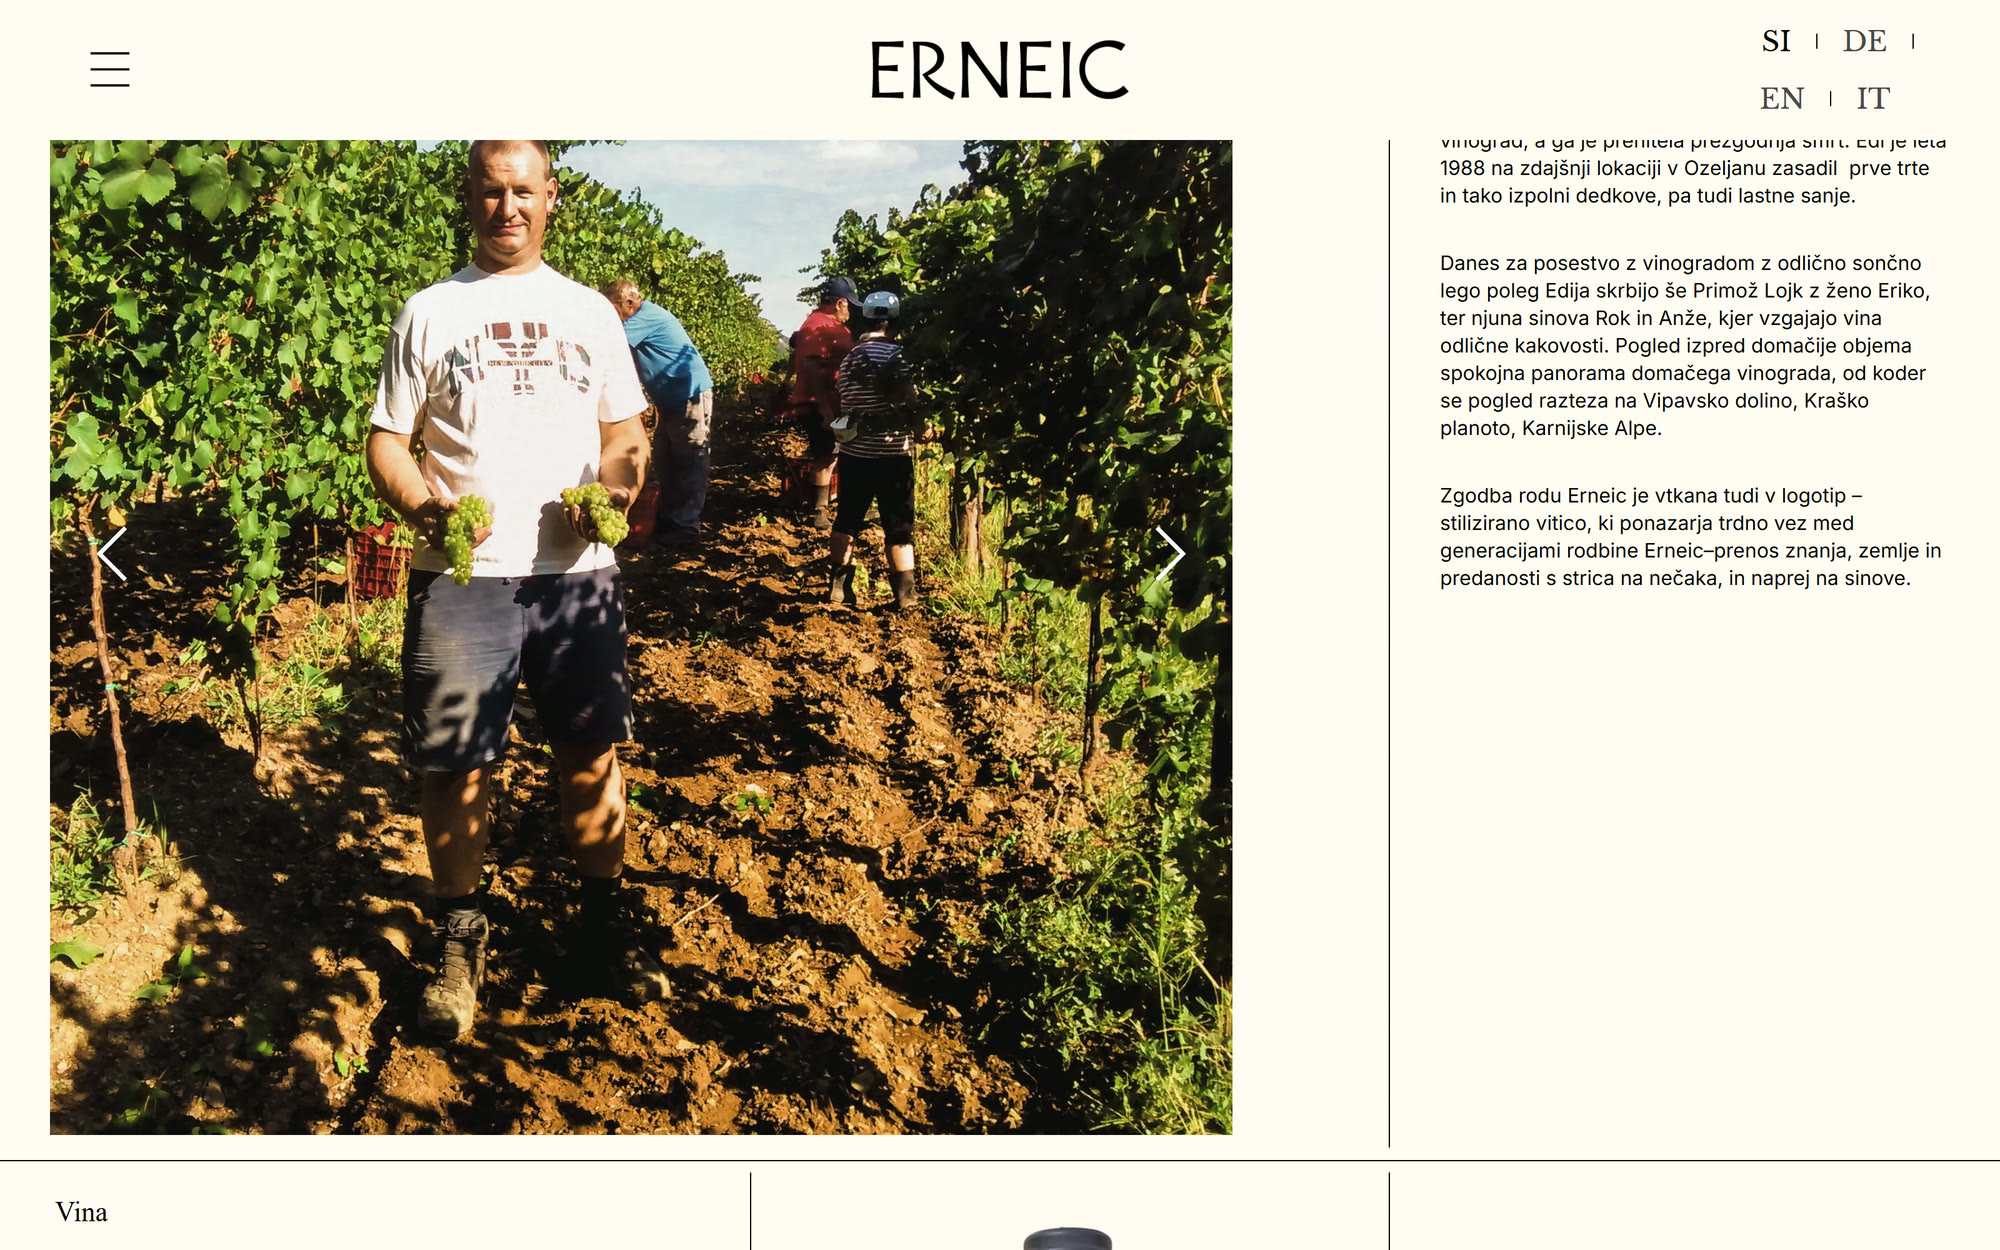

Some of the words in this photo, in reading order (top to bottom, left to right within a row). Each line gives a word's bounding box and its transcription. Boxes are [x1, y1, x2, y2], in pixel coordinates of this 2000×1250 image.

[1762, 30, 1790, 52] SI
[1843, 30, 1887, 52] DE
[872, 40, 1129, 100] ERNEIC
[1760, 87, 1804, 110] EN
[1857, 87, 1891, 110] IT
[1441, 160, 1485, 175] 1988
[1492, 164, 1513, 176] na
[1520, 159, 1590, 179] zdajšnji
[1598, 160, 1660, 179] lokaciji
[1668, 164, 1678, 175] v
[1685, 160, 1765, 179] Ozeljanu
[1773, 160, 1837, 176] zasadil
[1850, 164, 1891, 180] prve
[1897, 161, 1929, 176] trte
[1441, 187, 1456, 203] in
[1462, 188, 1502, 203] tako
[1509, 187, 1569, 207] izpolni
[1576, 188, 1661, 206] dedkove,
[1669, 191, 1690, 207] pa
[1697, 187, 1732, 203] tudi
[1739, 188, 1794, 203] lastne
[1802, 187, 1855, 207] sanje.
[1441, 255, 1499, 271] Danes
[1506, 259, 1527, 270] za
[1535, 256, 1619, 275] posestvo
[1627, 259, 1636, 270] z
[1643, 255, 1754, 275] vinogradom
[1762, 259, 1771, 270] z
[1778, 254, 1846, 271] odlično
[1853, 254, 1921, 271] sončno
[1441, 283, 1480, 302] lego
[1488, 283, 1538, 302] poleg
[1546, 282, 1589, 302] Edija
[1597, 282, 1658, 302] skrbijo
[1666, 282, 1686, 298] še
[1694, 282, 1758, 298] Primož
[1765, 282, 1803, 302] Lojk
[1810, 286, 1819, 298] z
[1826, 282, 1871, 298] ženo
[1879, 282, 1929, 301] Eriko,
[1440, 311, 1465, 326] ter
[1472, 310, 1522, 329] njuna
[1529, 310, 1588, 326] sinova
[1597, 310, 1630, 326] Rok
[1637, 310, 1652, 325] in
[1659, 309, 1711, 329] Anže,
[1720, 310, 1753, 329] kjer
[1759, 310, 1837, 330] vzgajajo
[1844, 310, 1881, 326] vina
[1441, 337, 1508, 353] odlične
[1516, 337, 1608, 353] kakovosti.
[1617, 338, 1680, 357] Pogled
[1687, 337, 1744, 357] izpred
[1752, 337, 1836, 357] domačije
[1843, 337, 1911, 357] objema
[1441, 365, 1524, 384] spokojna
[1532, 368, 1625, 384] panorama
[1632, 364, 1730, 385] domačega
[1737, 365, 1835, 385] vinograda,
[1843, 365, 1865, 381] od
[1874, 365, 1926, 381] koder
[1441, 396, 1462, 408] se
[1469, 393, 1532, 412] pogled
[1540, 394, 1607, 408] razteza
[1616, 396, 1636, 408] na
[1643, 392, 1728, 412] Vipavsko
[1736, 392, 1797, 411] dolino,
[1805, 392, 1868, 408] Kraško
[1441, 420, 1515, 440] planoto,
[1523, 420, 1608, 439] Karnijske
[1615, 420, 1661, 440] Alpe.
[1441, 488, 1512, 507] Zgodba
[1520, 488, 1561, 503] rodu
[1569, 487, 1626, 503] Erneic
[1632, 487, 1648, 507] je
[1655, 488, 1717, 503] vtkana
[1723, 487, 1758, 503] tudi
[1765, 491, 1775, 503] v
[1783, 487, 1846, 507] logotip
[1441, 515, 1529, 531] stilizirano
[1536, 515, 1591, 534] vitico,
[1599, 515, 1613, 530] ki
[1621, 515, 1712, 535] ponazarja
[1719, 515, 1768, 531] trdno
[1774, 519, 1806, 530] vez
[1814, 515, 1853, 530] med
[1441, 542, 1560, 562] generacijami
[1568, 542, 1638, 558] rodbine
[1645, 542, 1779, 562] Erneic–prenos
[1786, 542, 1851, 562] znanja,
[1859, 542, 1919, 562] zemlje
[1926, 542, 1941, 558] in
[1441, 570, 1539, 590] predanosti
[1547, 574, 1556, 586] s
[1563, 570, 1613, 586] strica
[1622, 574, 1642, 586] na
[1650, 569, 1722, 589] nečaka,
[1730, 570, 1744, 585] in
[1752, 570, 1809, 589] naprej
[1817, 574, 1837, 585] na
[1845, 570, 1910, 586] sinove.
[55, 1201, 108, 1222] Vina
